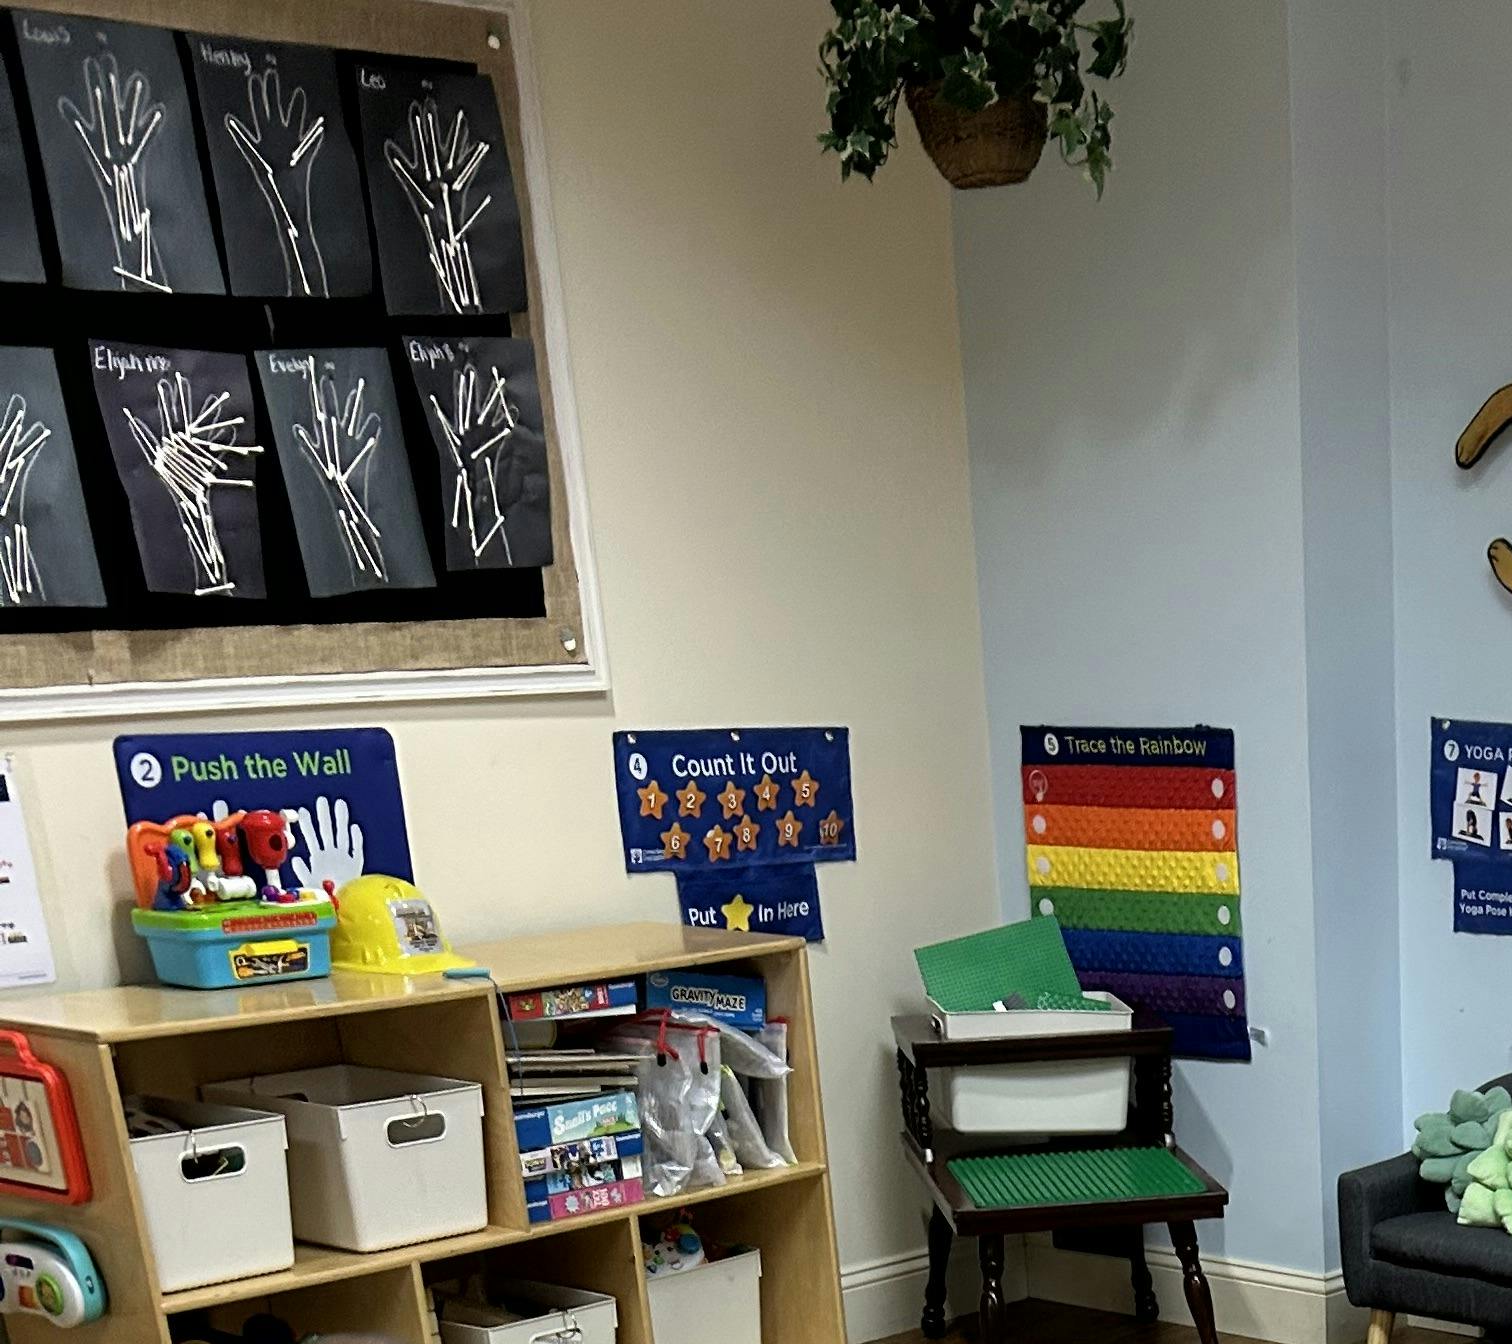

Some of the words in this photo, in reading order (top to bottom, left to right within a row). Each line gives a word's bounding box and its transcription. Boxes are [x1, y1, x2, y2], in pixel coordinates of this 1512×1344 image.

[361, 67, 387, 89] Leo
[1047, 737, 1056, 753] 5
[1063, 735, 1106, 755] Trace
[1110, 736, 1135, 756] the
[1139, 734, 1207, 757] Rainbow
[1448, 744, 1456, 759] 7
[1464, 744, 1505, 761] YOGA
[139, 759, 155, 782] 2
[170, 753, 239, 782] Push
[244, 753, 288, 780] the
[292, 749, 352, 777] Wall
[632, 758, 643, 773] 4
[671, 753, 736, 777] Count
[740, 753, 756, 775] It
[761, 752, 798, 775] Out
[762, 786, 772, 802] 4
[801, 783, 811, 799] 5
[686, 793, 696, 810] 2
[728, 794, 737, 810] 3
[742, 827, 751, 843] 8
[785, 823, 794, 838] 9
[823, 822, 838, 838] 10
[671, 835, 681, 850] 6
[715, 838, 723, 854] 7
[1460, 889, 1477, 901] Put
[688, 906, 718, 927] Put
[758, 904, 774, 923] In
[777, 901, 810, 921] Here
[1459, 902, 1484, 917] Yoga
[1485, 904, 1507, 917] Pose
[671, 986, 717, 1005] GRAVITY
[713, 996, 746, 1011] MAZE
